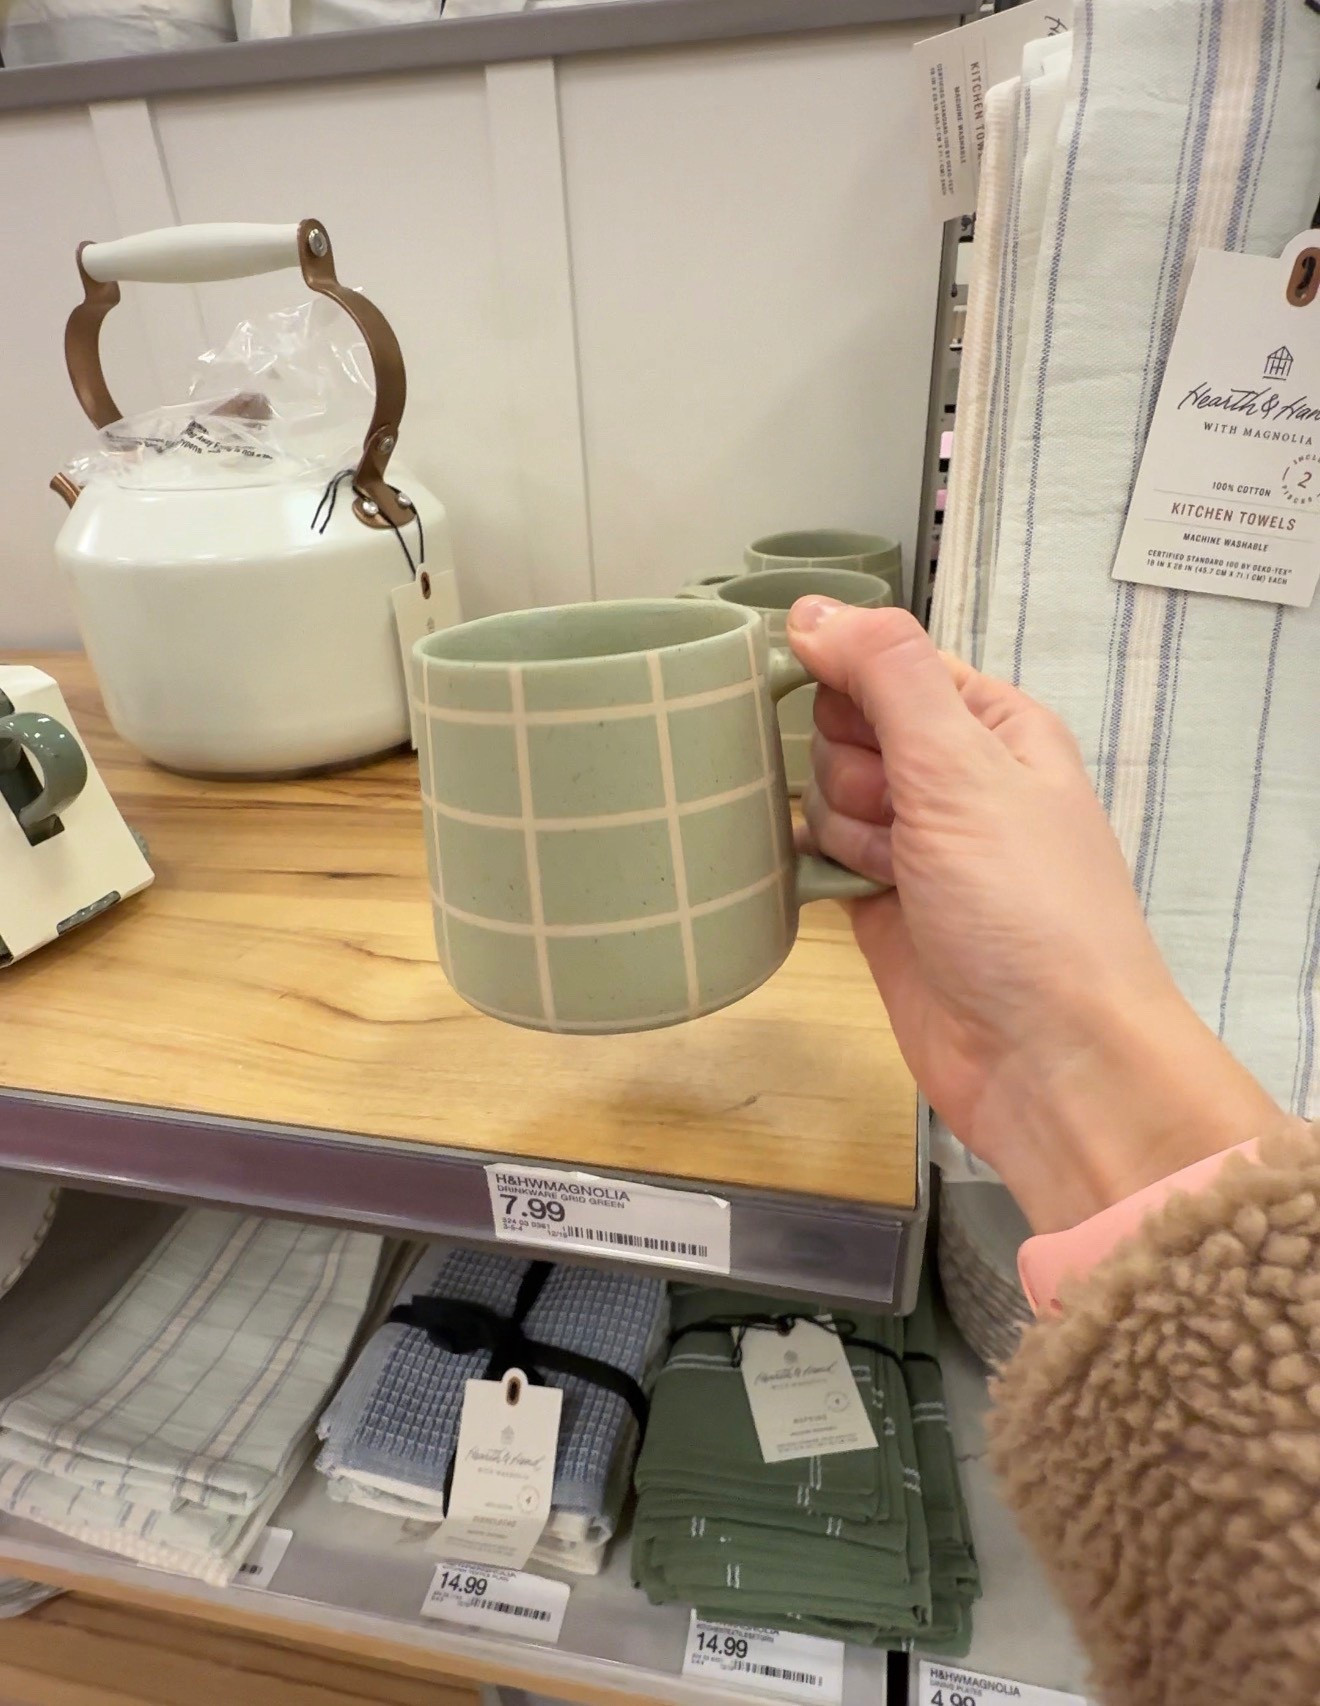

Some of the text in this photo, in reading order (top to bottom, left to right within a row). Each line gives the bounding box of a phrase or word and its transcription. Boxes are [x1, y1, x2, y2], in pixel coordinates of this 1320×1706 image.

[970, 61, 984, 120] KITCHEN
[1177, 381, 1320, 421] Hearth & Han
[1203, 421, 1313, 446] WITH MAGNOLIA
[1212, 481, 1271, 497] 100% COTTON
[1297, 471, 1312, 489] 2
[1171, 502, 1296, 531] KITCHEN TOWELS
[1183, 533, 1269, 552] MACHINE WASHABLE
[1148, 549, 1184, 561] CERTIFIED
[1186, 555, 1224, 567] STANDARD
[1226, 561, 1239, 569] 100
[496, 1174, 630, 1202] H&HWMAGNOLIA
[497, 1184, 558, 1199] DRINKWARE
[588, 1198, 625, 1209] GREEN
[499, 1193, 566, 1222] 7.99
[441, 1571, 488, 1596] 14.99
[697, 1632, 748, 1658] 14.99
[930, 1668, 1021, 1698] H&HWMAGNOLIA
